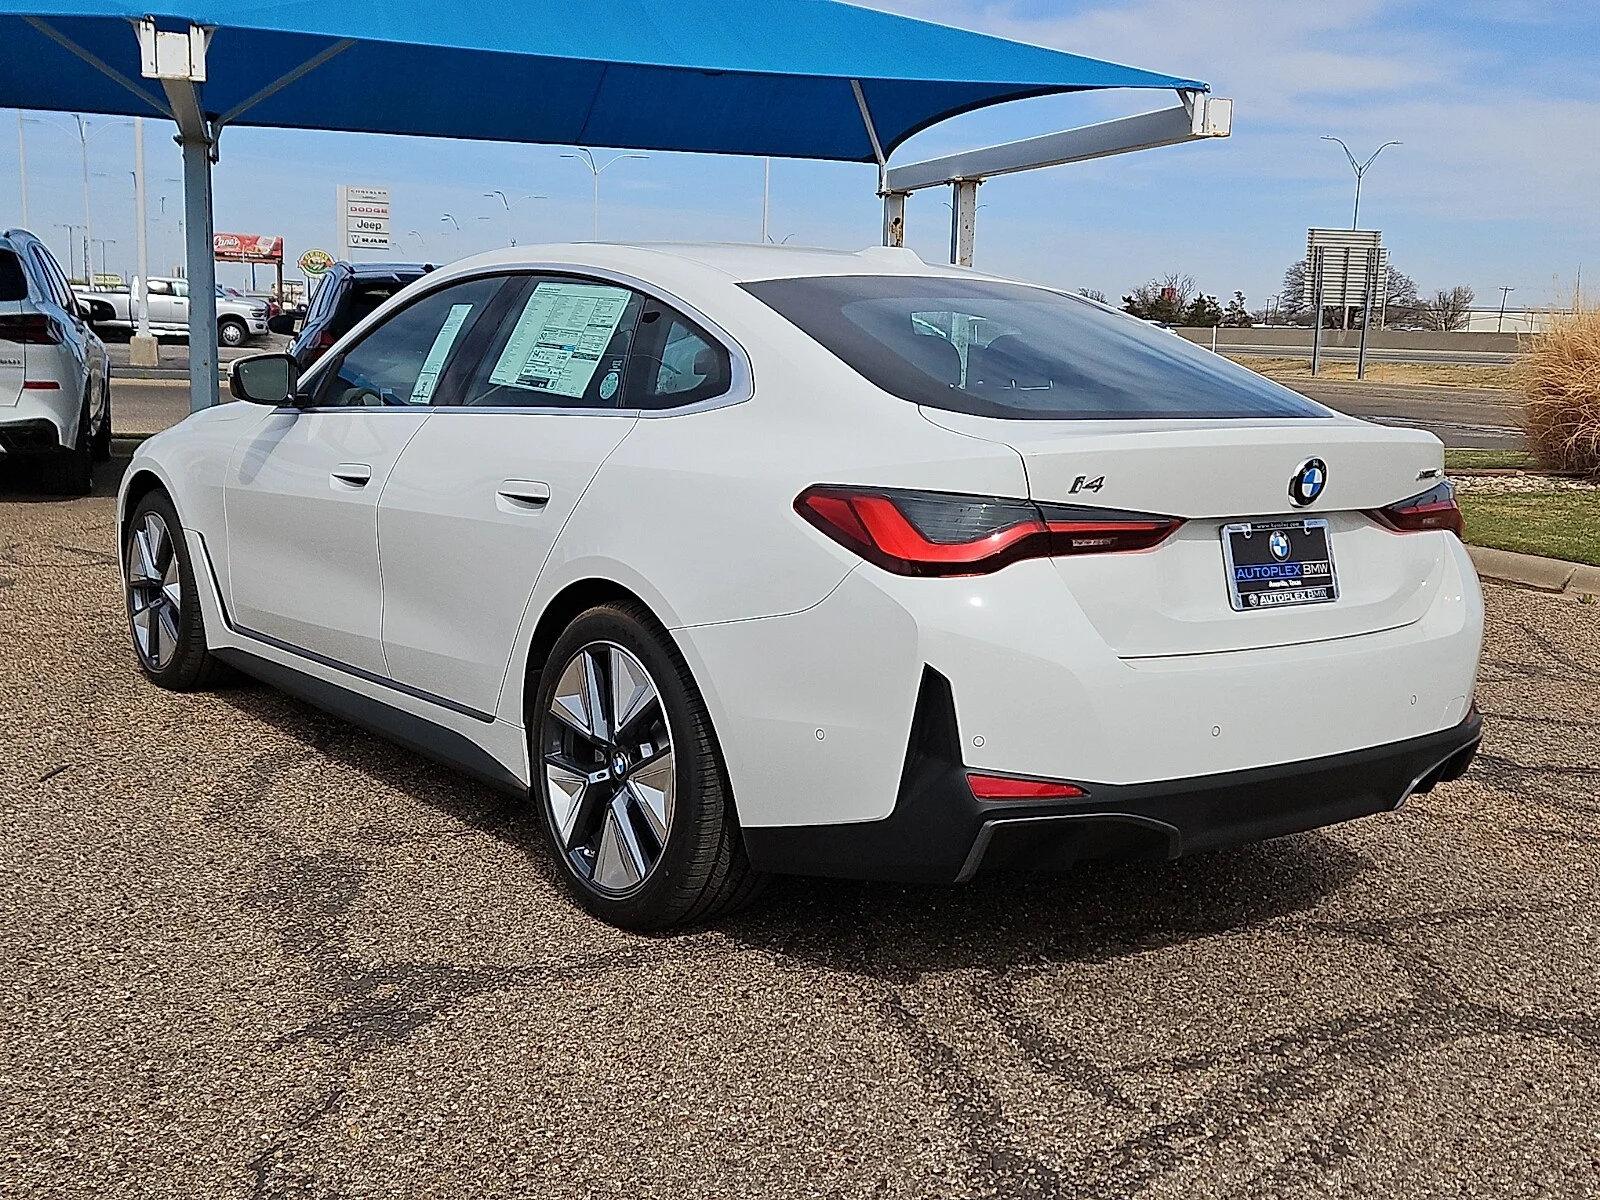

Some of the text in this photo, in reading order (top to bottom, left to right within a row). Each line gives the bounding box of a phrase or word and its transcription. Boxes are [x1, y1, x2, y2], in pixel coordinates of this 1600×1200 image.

[350, 206, 388, 214] DODGE
[356, 219, 382, 231] Jeep
[1067, 475, 1106, 494] i4
[1237, 563, 1328, 579] AUTOPLEX BMW
[1260, 588, 1327, 605] AUTOPLEX BMW
